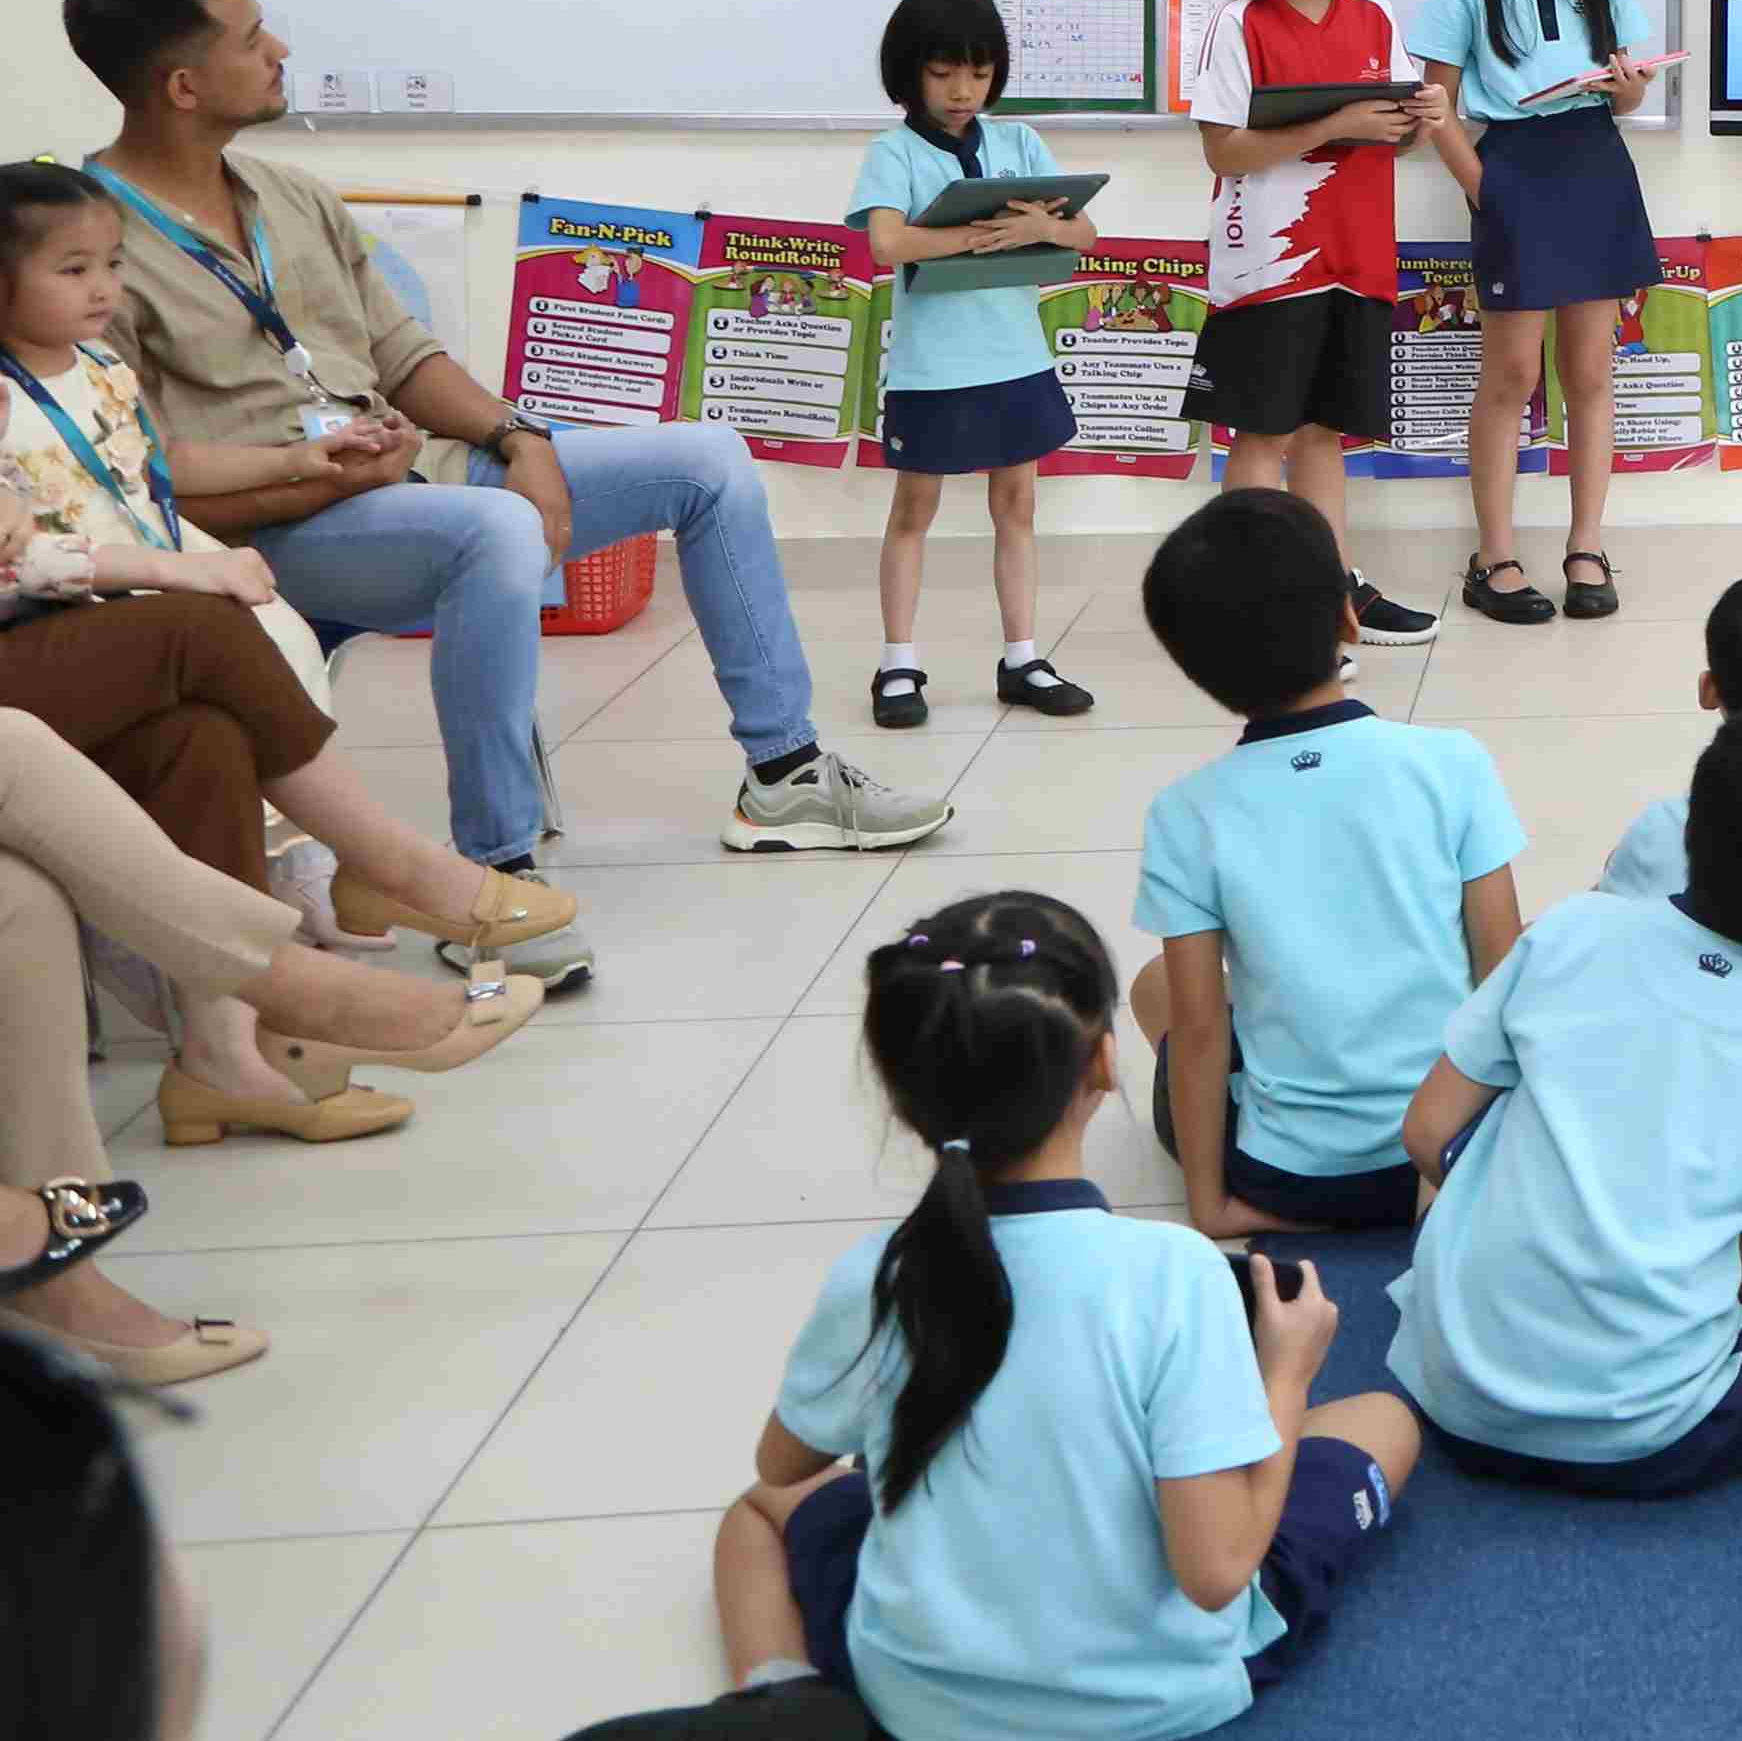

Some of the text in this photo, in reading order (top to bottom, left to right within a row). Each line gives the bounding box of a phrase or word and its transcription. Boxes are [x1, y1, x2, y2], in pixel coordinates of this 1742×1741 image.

[550, 218, 672, 247] Fan-N-Pick
[727, 232, 846, 254] Think-Write-
[725, 246, 841, 268] RoundRobin
[1074, 257, 1204, 276] lking Chips
